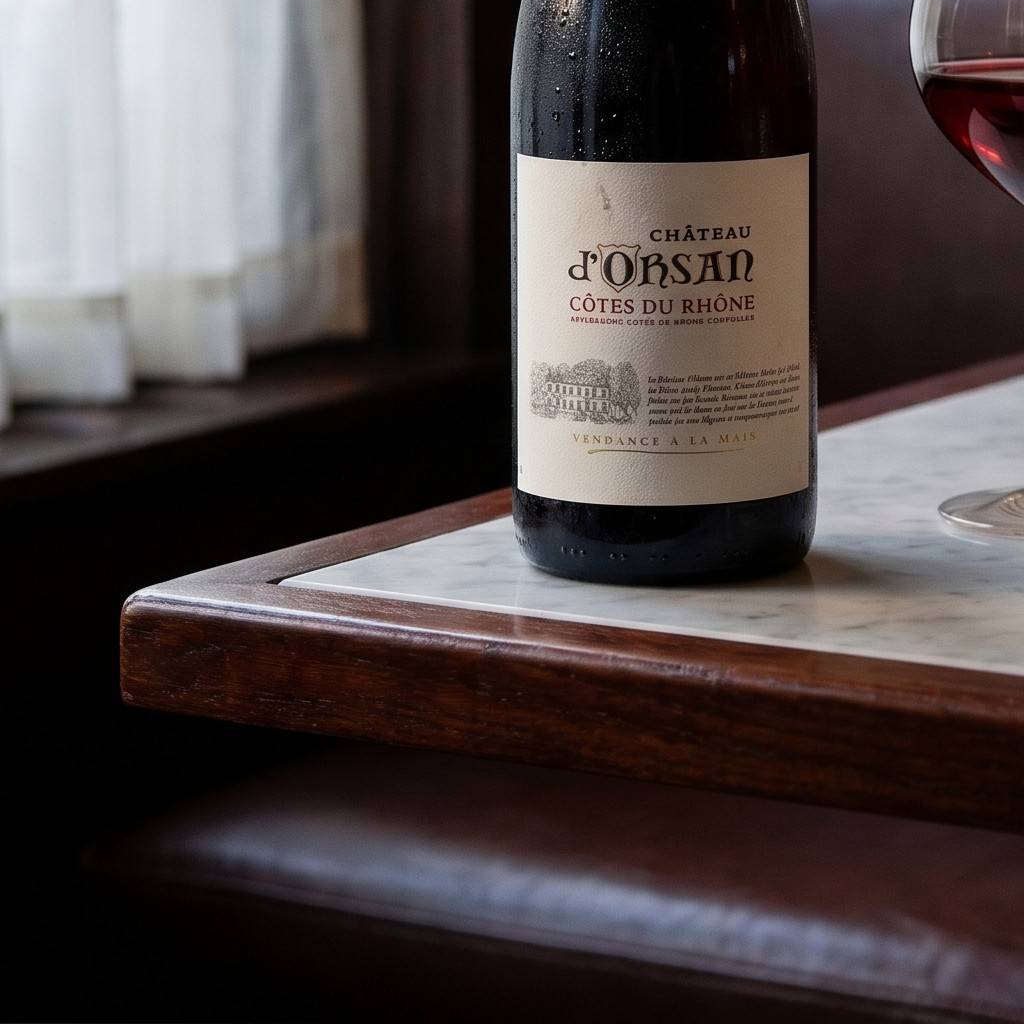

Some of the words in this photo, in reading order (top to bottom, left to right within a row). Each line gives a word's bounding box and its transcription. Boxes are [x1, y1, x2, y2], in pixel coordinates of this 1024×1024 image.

[649, 224, 751, 243] CHÂTEAU
[569, 292, 635, 314] CÔTES
[642, 298, 674, 315] DU
[681, 292, 756, 314] RHÔNE
[690, 435, 709, 447] LA
